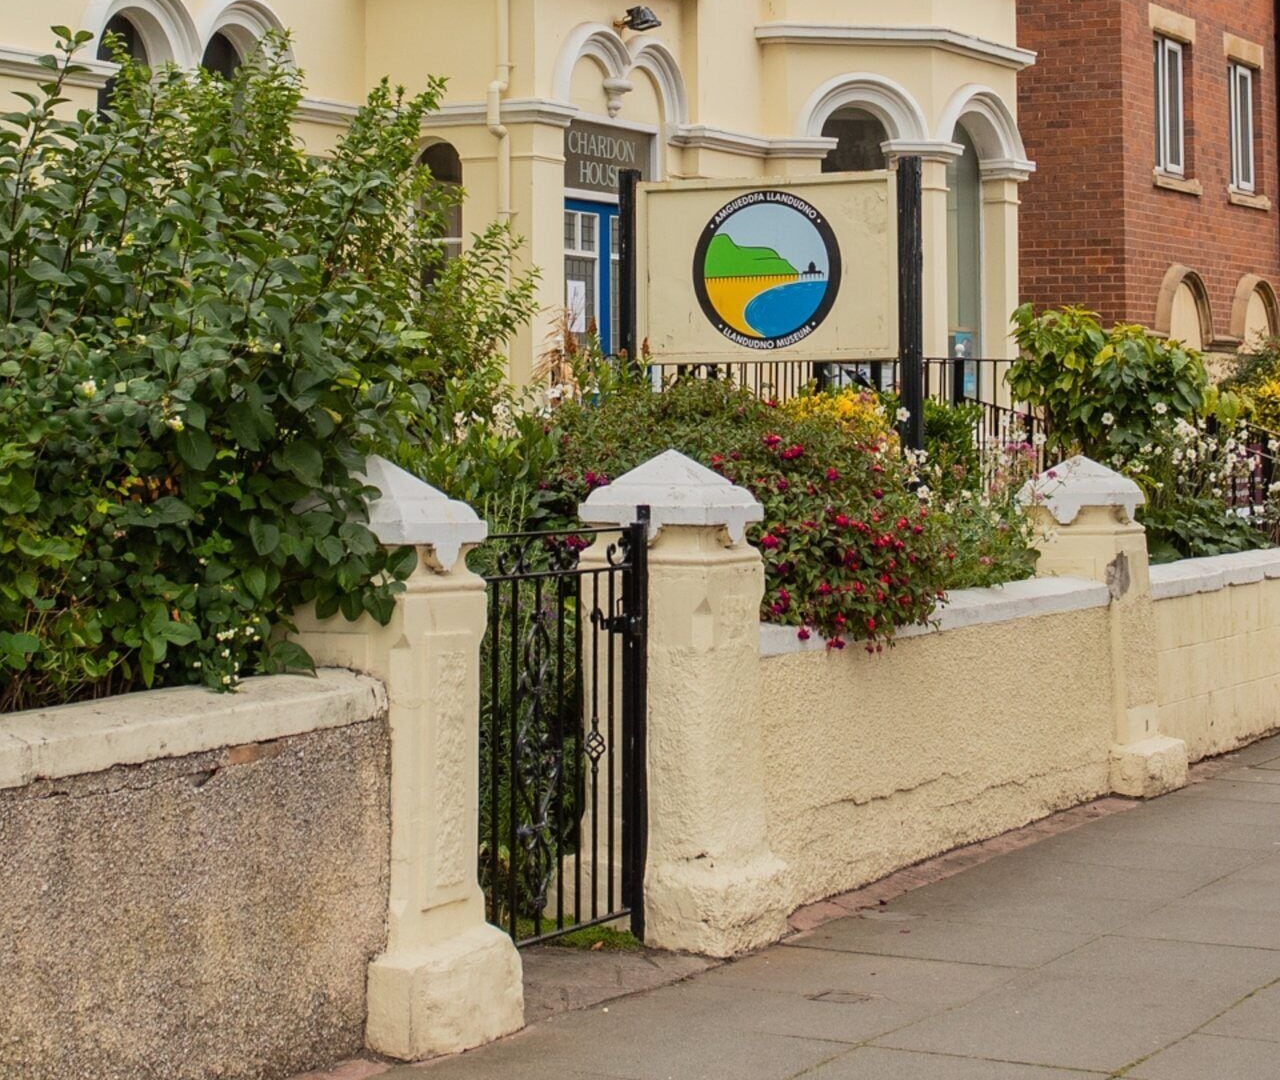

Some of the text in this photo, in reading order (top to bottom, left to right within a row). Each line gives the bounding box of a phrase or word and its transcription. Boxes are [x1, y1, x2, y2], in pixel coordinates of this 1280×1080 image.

[568, 130, 636, 164] CHARDON
[714, 192, 817, 224] AMGUEDDFA LLANDUDNO
[723, 325, 811, 349] LLANDUDNO MUSEUM
